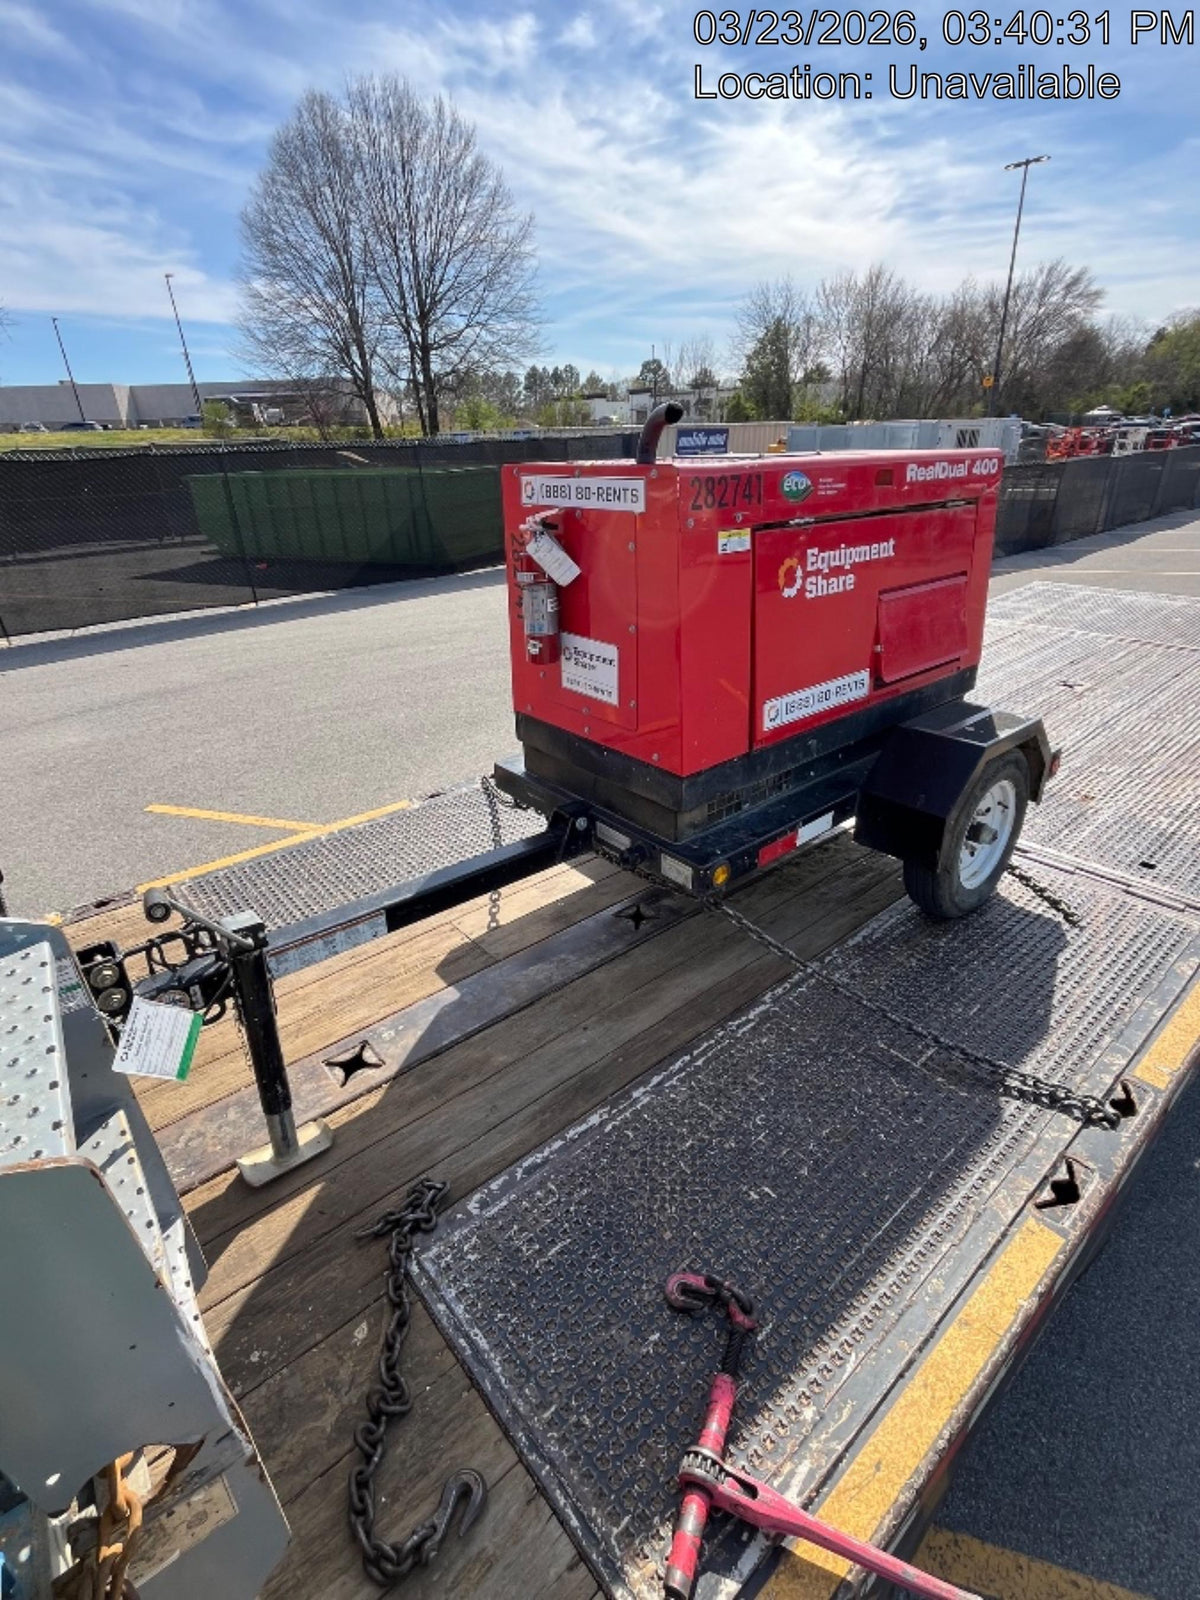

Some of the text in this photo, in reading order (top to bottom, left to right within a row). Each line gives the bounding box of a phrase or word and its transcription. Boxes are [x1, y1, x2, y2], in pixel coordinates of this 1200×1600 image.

[972, 458, 998, 476] 400
[541, 483, 639, 504] (888) 80-RENTS
[690, 473, 762, 511] 282741
[806, 537, 896, 573] Equipment
[805, 573, 855, 600] Share
